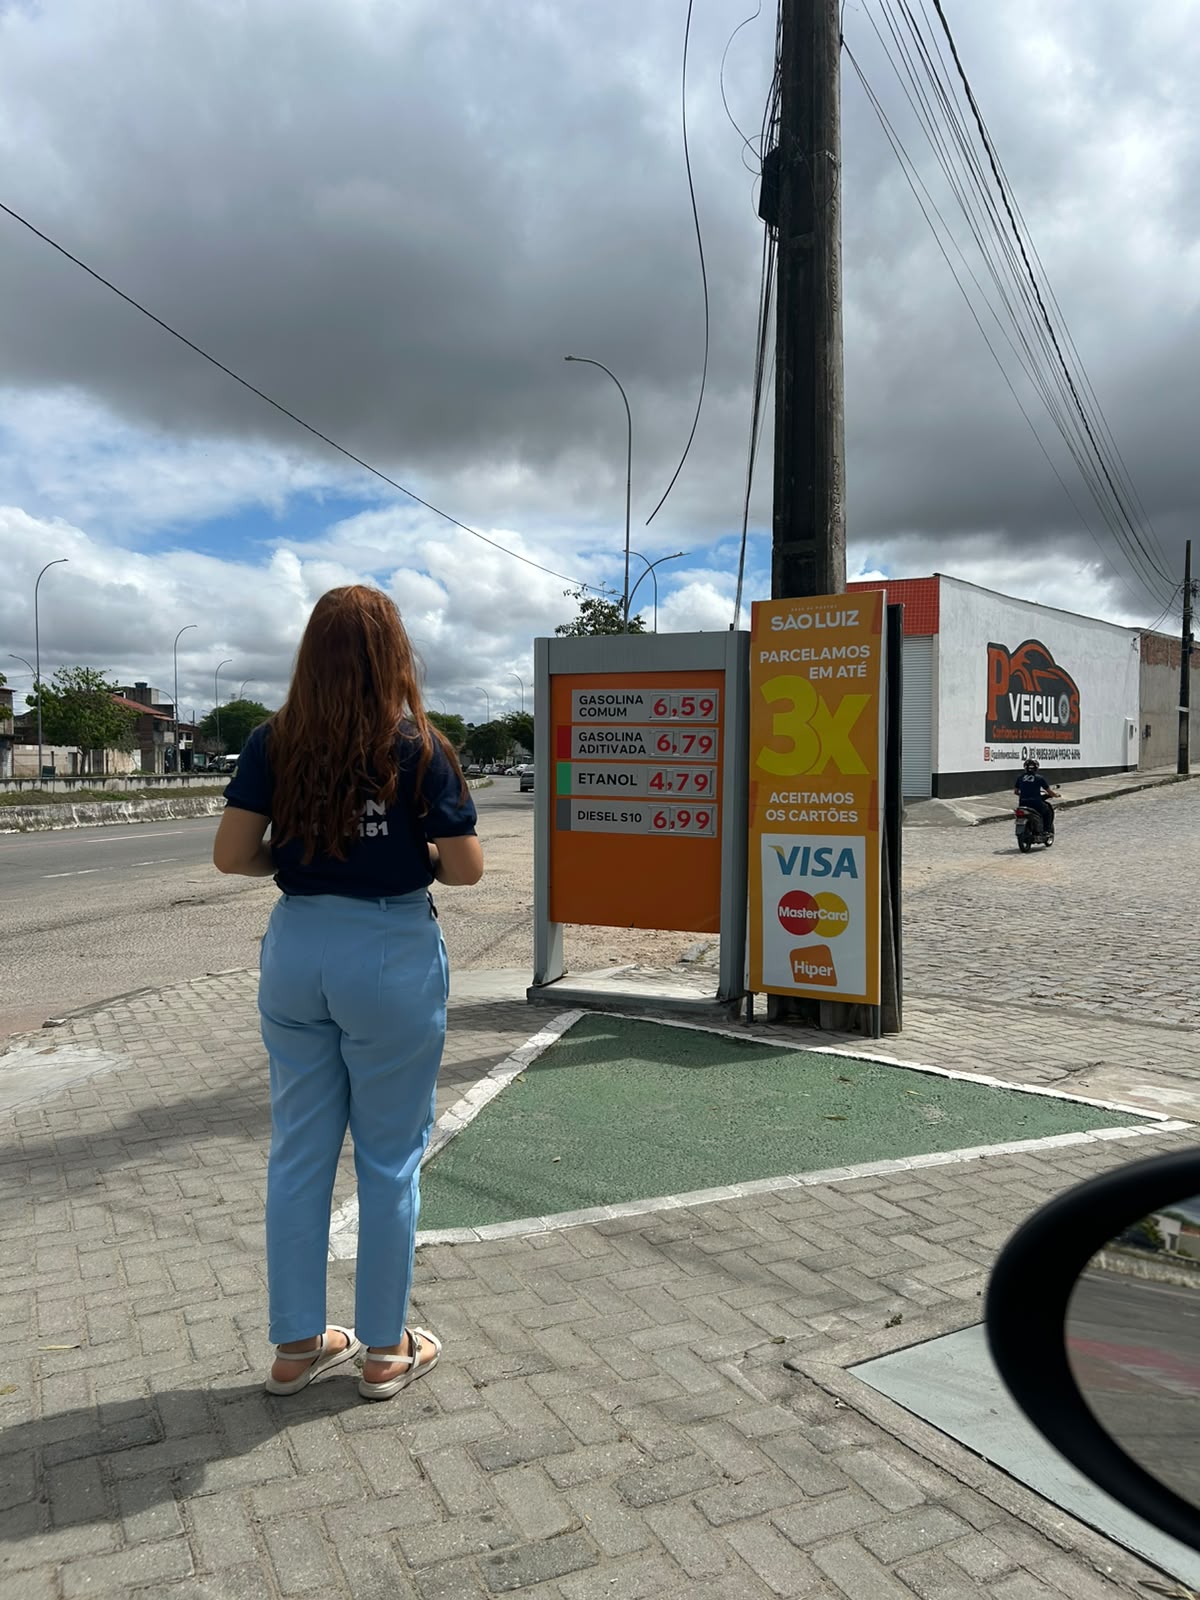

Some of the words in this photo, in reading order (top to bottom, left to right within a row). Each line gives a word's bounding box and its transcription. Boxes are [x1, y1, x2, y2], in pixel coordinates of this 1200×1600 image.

[815, 610, 859, 628] LUIZ
[760, 645, 871, 663] PARCELAMOS
[809, 666, 833, 679] EM
[836, 661, 867, 678] ATÉ
[579, 695, 644, 706] GASOLINA
[653, 697, 714, 717] 6,59
[579, 707, 627, 717] COMUM
[755, 675, 873, 776] 3X
[578, 732, 643, 743] GASOLINA
[656, 734, 713, 754] 6,79
[578, 744, 646, 755] ADITIVADA
[578, 773, 638, 786] ETANOL
[649, 772, 709, 792] 4,79
[769, 792, 854, 805] ACEITAMOS
[577, 810, 618, 822] DIESEL
[620, 812, 642, 823] S10
[653, 809, 710, 829] 6,99
[765, 809, 786, 821] OS
[788, 807, 858, 823] CARTÕES
[768, 845, 859, 879] VISA
[778, 906, 848, 922] MasterCard
[793, 960, 833, 978] Hiper
